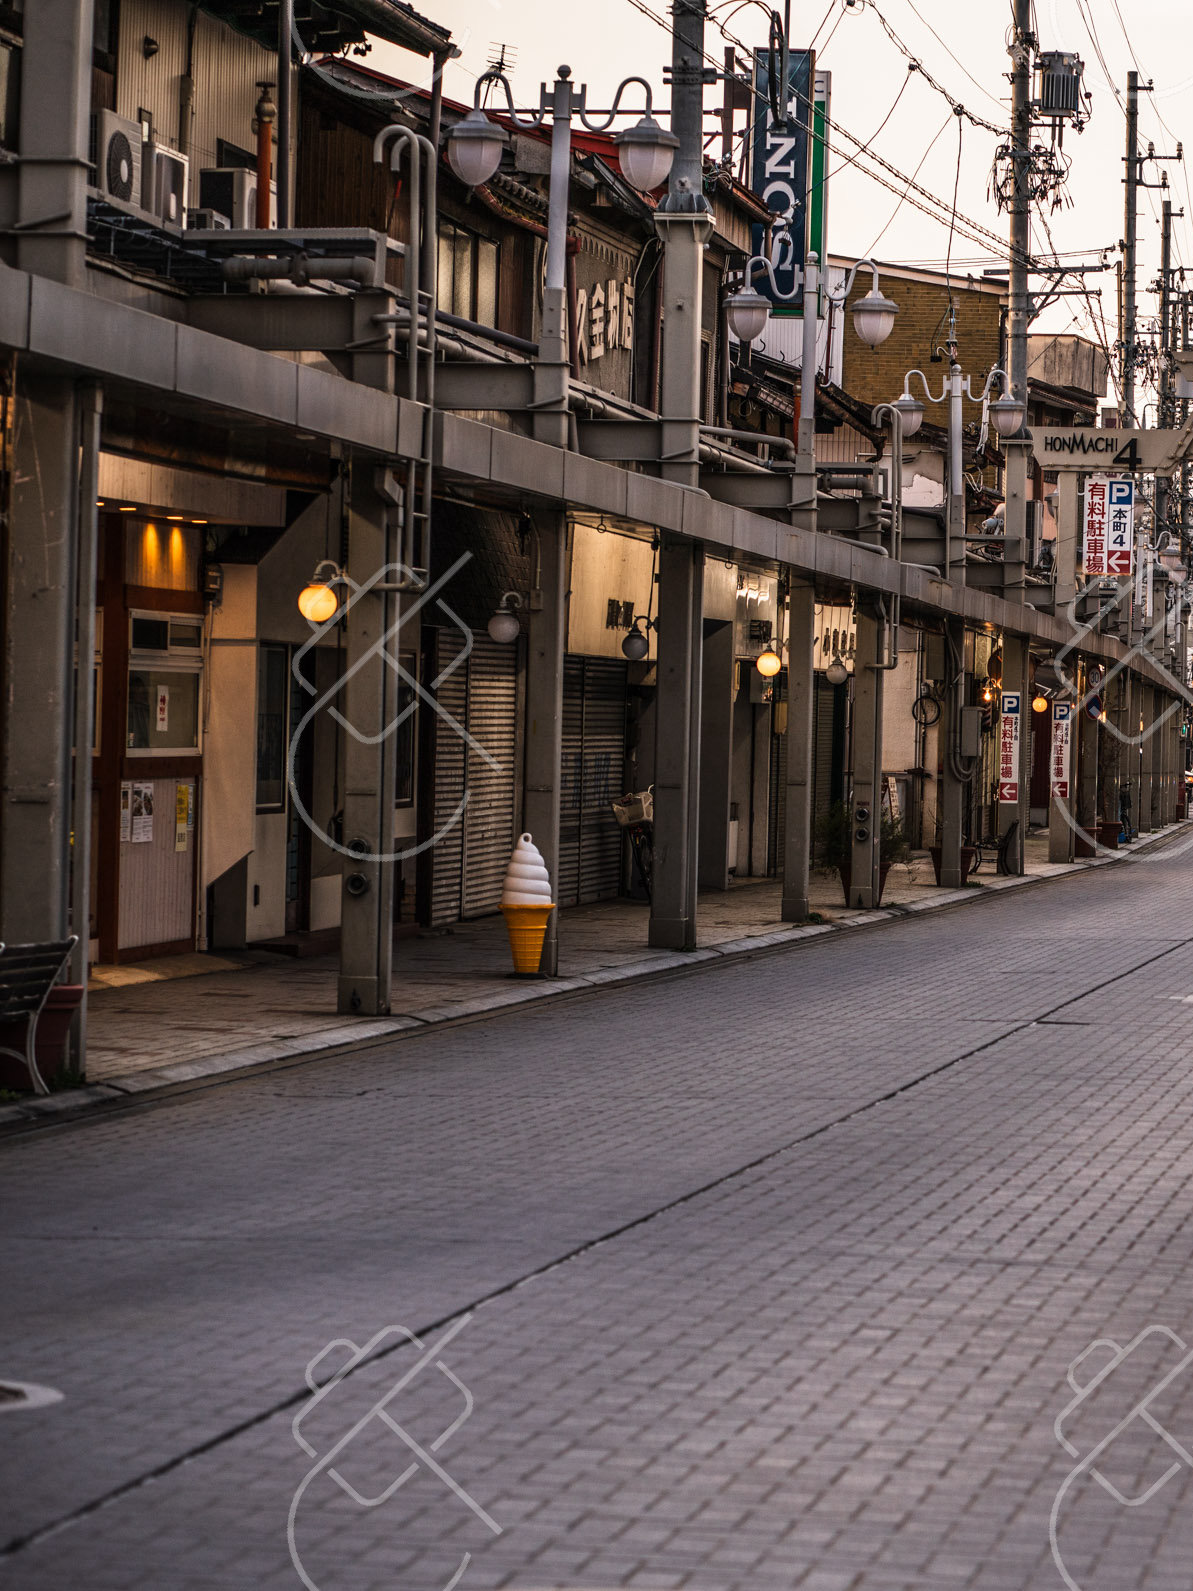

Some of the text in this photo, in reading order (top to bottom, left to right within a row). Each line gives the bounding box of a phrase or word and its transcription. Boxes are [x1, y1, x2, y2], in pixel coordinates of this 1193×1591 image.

[1044, 432, 1142, 471] HONMACHI 4
[1111, 483, 1130, 503] P
[1085, 482, 1107, 573] 有料駐車場
[1112, 507, 1128, 547] 本町4
[1090, 671, 1100, 684] 30
[1003, 697, 1018, 712] P
[1055, 705, 1068, 719] P
[1001, 715, 1014, 779] 有料駐車場
[1053, 722, 1065, 778] 有料駐車場
